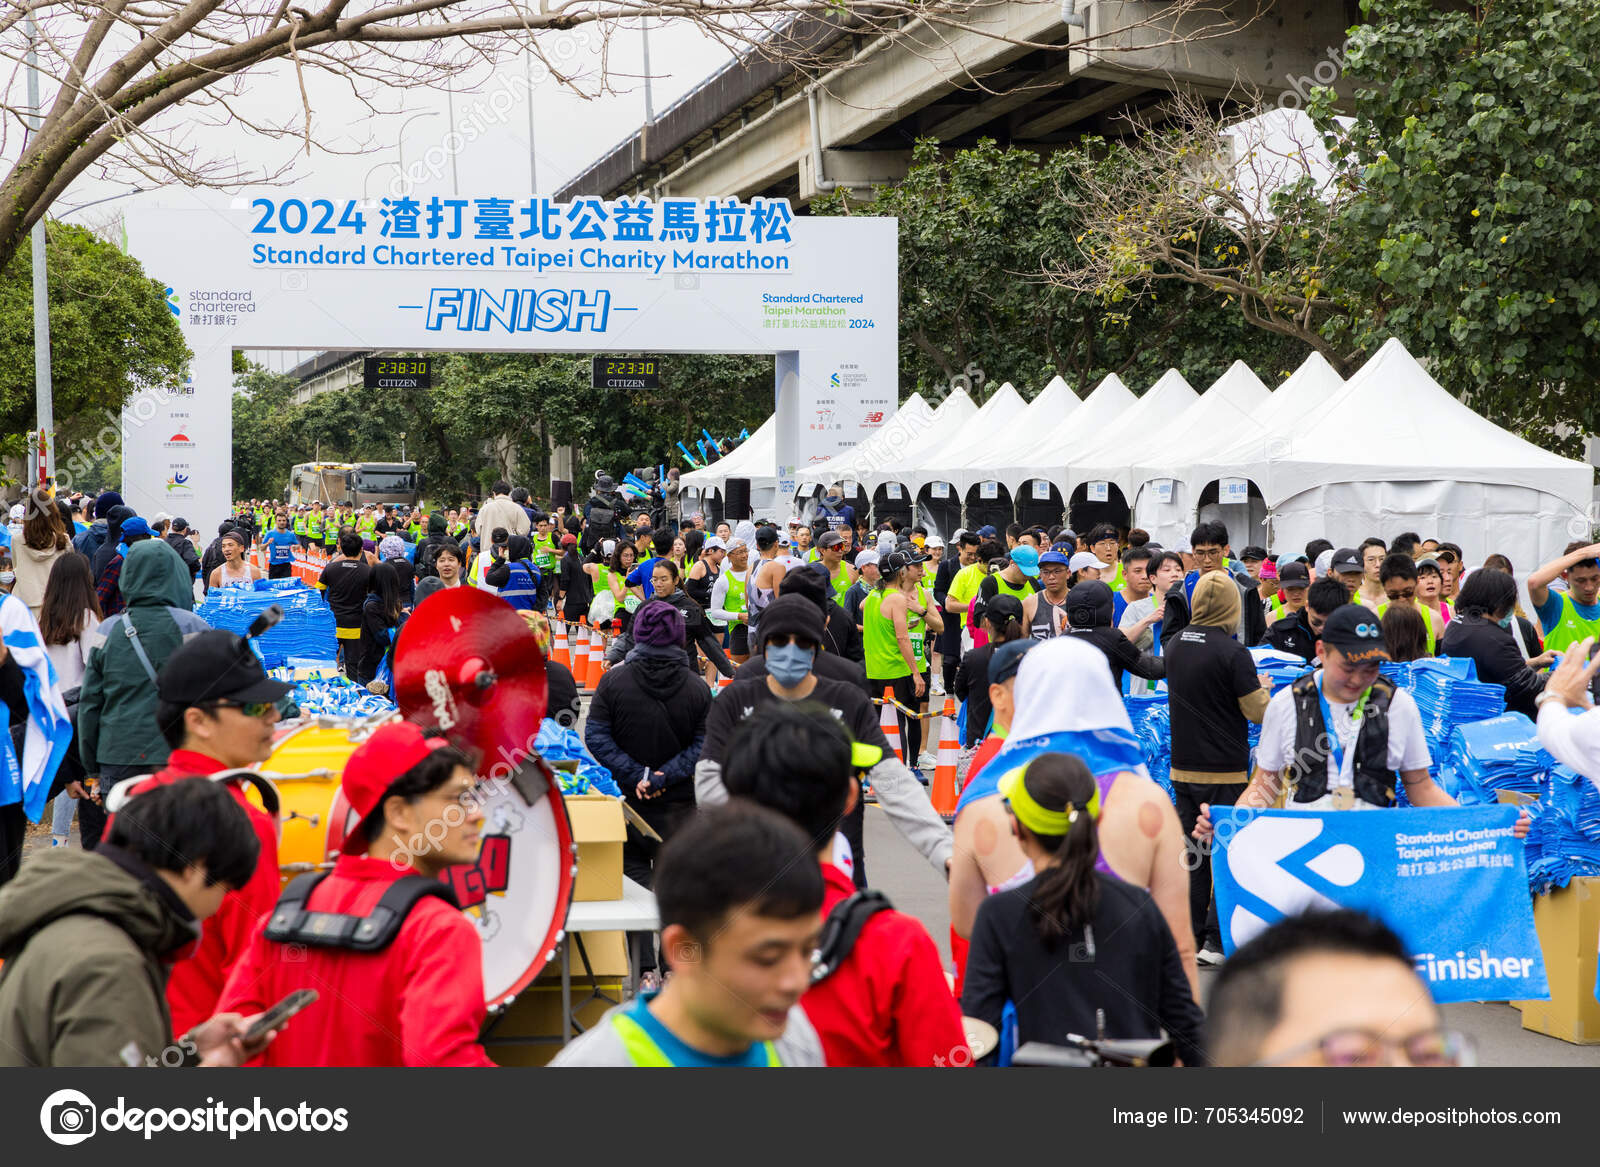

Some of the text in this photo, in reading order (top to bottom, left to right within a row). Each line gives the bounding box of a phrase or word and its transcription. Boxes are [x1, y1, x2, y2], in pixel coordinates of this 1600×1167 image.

[251, 196, 793, 244] 2024 渣打臺北公益馬拉松
[252, 244, 789, 273] Standard Chartered Taipei Charity Marathon
[189, 290, 252, 301] standard
[762, 293, 864, 304] Standard Chartered
[189, 301, 256, 313] chartered
[425, 287, 611, 333] FINISH
[762, 305, 846, 317] Taipei Marathon
[189, 314, 238, 326] 渣打銀行
[848, 319, 875, 329] 2024
[378, 362, 426, 374] 2:38:30
[607, 362, 654, 375] 2:23:30
[378, 378, 417, 387] CITIZEN
[607, 378, 645, 388] CITIZEN
[1395, 825, 1515, 846] Standard Chartered
[1396, 840, 1497, 861] Taipei Marathon
